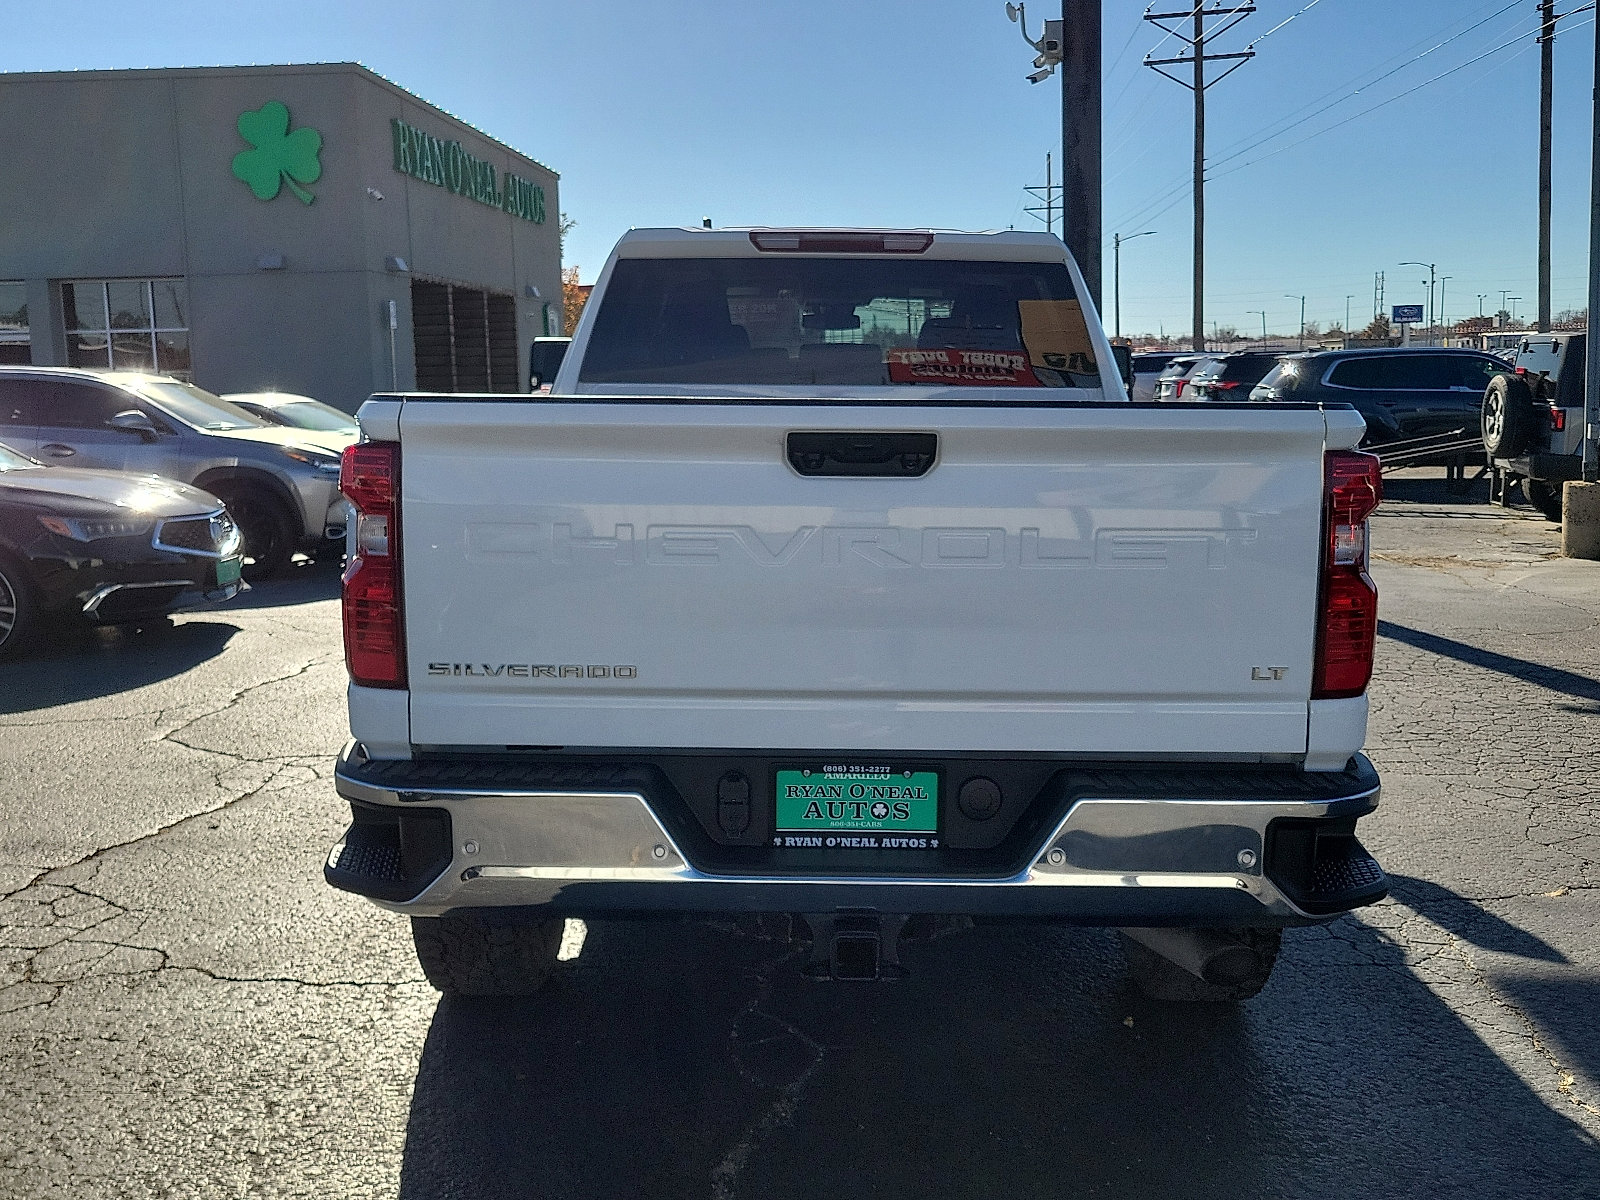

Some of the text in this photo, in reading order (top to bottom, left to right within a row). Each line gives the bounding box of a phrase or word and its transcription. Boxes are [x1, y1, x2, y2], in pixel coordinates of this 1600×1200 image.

[391, 119, 546, 224] RYAN O'NEAL AUTOS
[464, 522, 1258, 569] CHEVROLET
[427, 662, 638, 680] SILVERADO
[1251, 666, 1289, 680] LT
[823, 765, 890, 773] (806) 351-2277
[785, 784, 928, 800] RYAN O'NEAL
[802, 801, 910, 820] AUTOS
[785, 837, 927, 848] RYAN O'NEAL AUTOS
